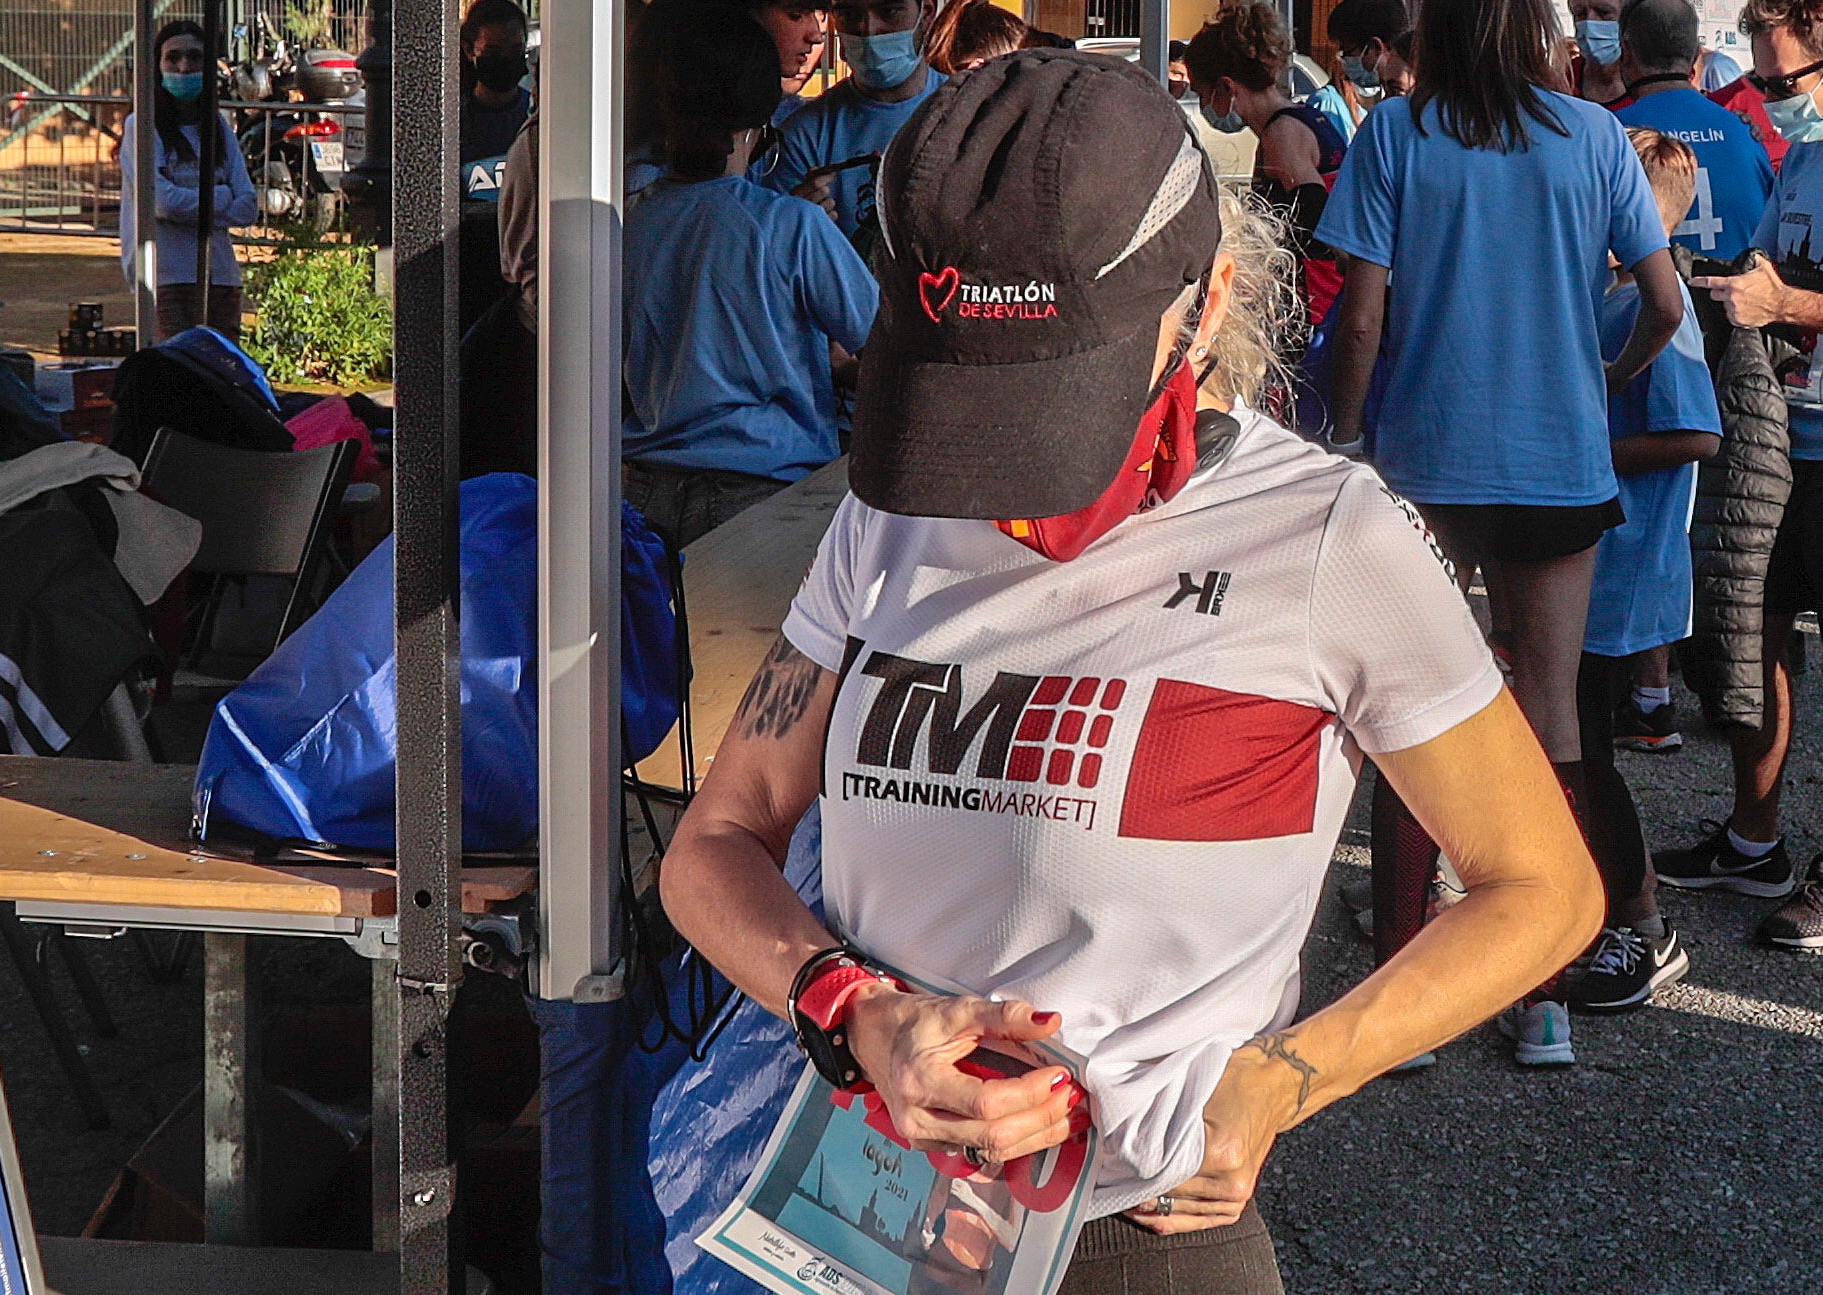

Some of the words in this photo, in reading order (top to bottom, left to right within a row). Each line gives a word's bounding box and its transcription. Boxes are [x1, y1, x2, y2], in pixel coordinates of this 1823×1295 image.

[960, 280, 1056, 304] TRIATLÓN
[958, 302, 981, 318] DE
[982, 303, 1059, 320] SEVILLA
[856, 650, 1043, 780] TM
[884, 1178, 910, 1203] 2021
